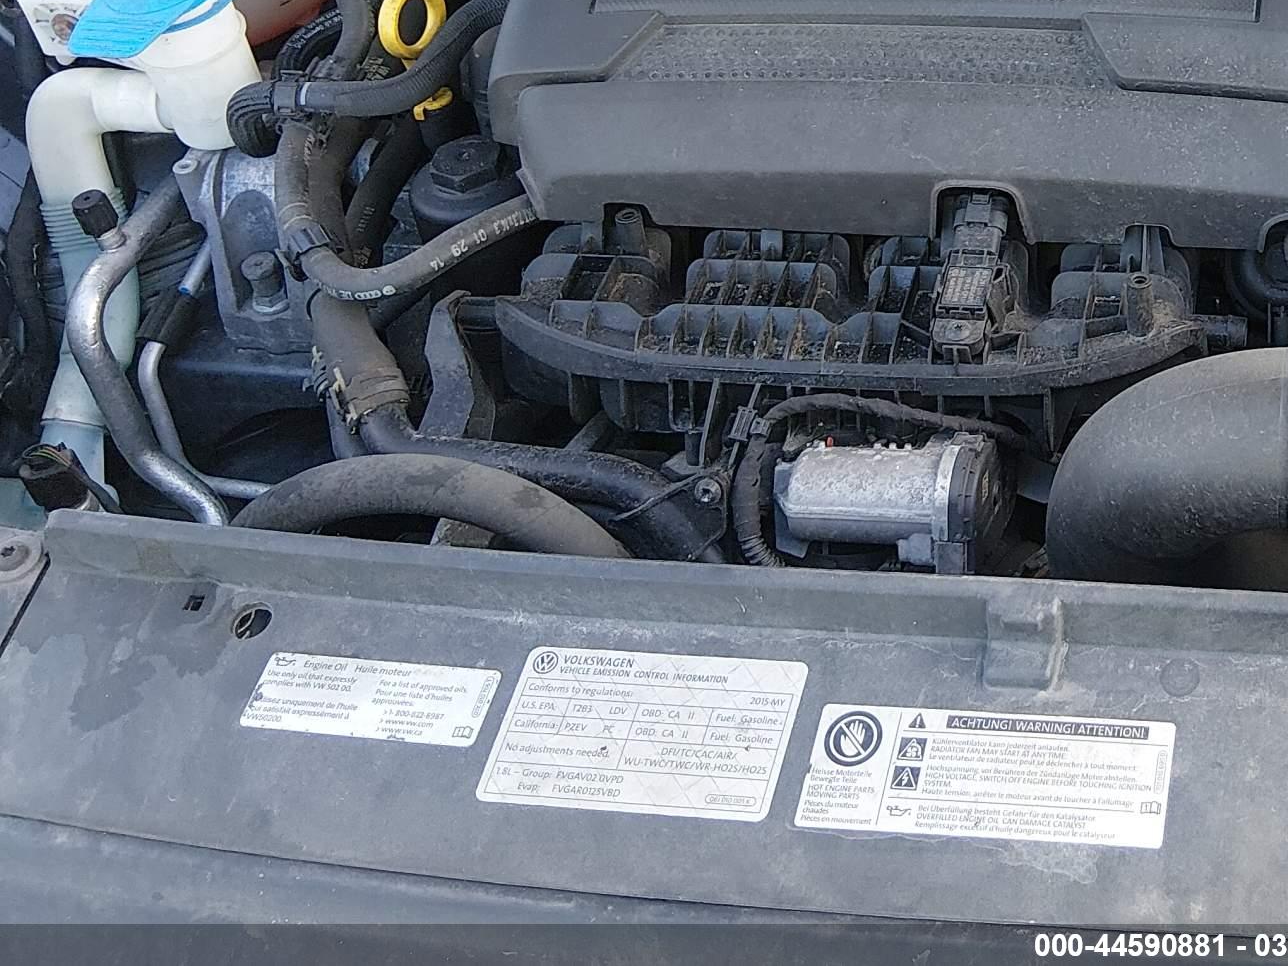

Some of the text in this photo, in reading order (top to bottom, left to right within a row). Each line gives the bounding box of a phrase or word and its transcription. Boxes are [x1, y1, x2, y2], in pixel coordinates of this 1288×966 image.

[304, 660, 333, 671] Engine
[564, 655, 635, 668] VOLKSWAGEN
[354, 665, 412, 676] Huile moteur
[560, 666, 729, 684] VEHICLE EMISSION CONTROL INFORMATION
[281, 671, 296, 679] only
[324, 676, 357, 685] expressly
[313, 682, 326, 690] VW
[379, 679, 391, 687] For
[419, 684, 453, 692] approved
[528, 684, 569, 694] Conforms
[572, 685, 580, 694] to
[375, 688, 392, 696] Pour
[609, 706, 628, 715] LDV
[668, 710, 680, 718] CA
[716, 714, 778, 725] Fuel: Gasoline
[565, 723, 587, 731] PZEV
[951, 717, 1145, 738] ACHTUNG! WARNING! ATTENTION!
[662, 730, 674, 738] CA
[735, 734, 773, 744] Gasoline
[505, 742, 517, 752] No
[519, 744, 574, 756] adjustments
[522, 769, 550, 780] Group:
[1051, 779, 1078, 787] BEFORE
